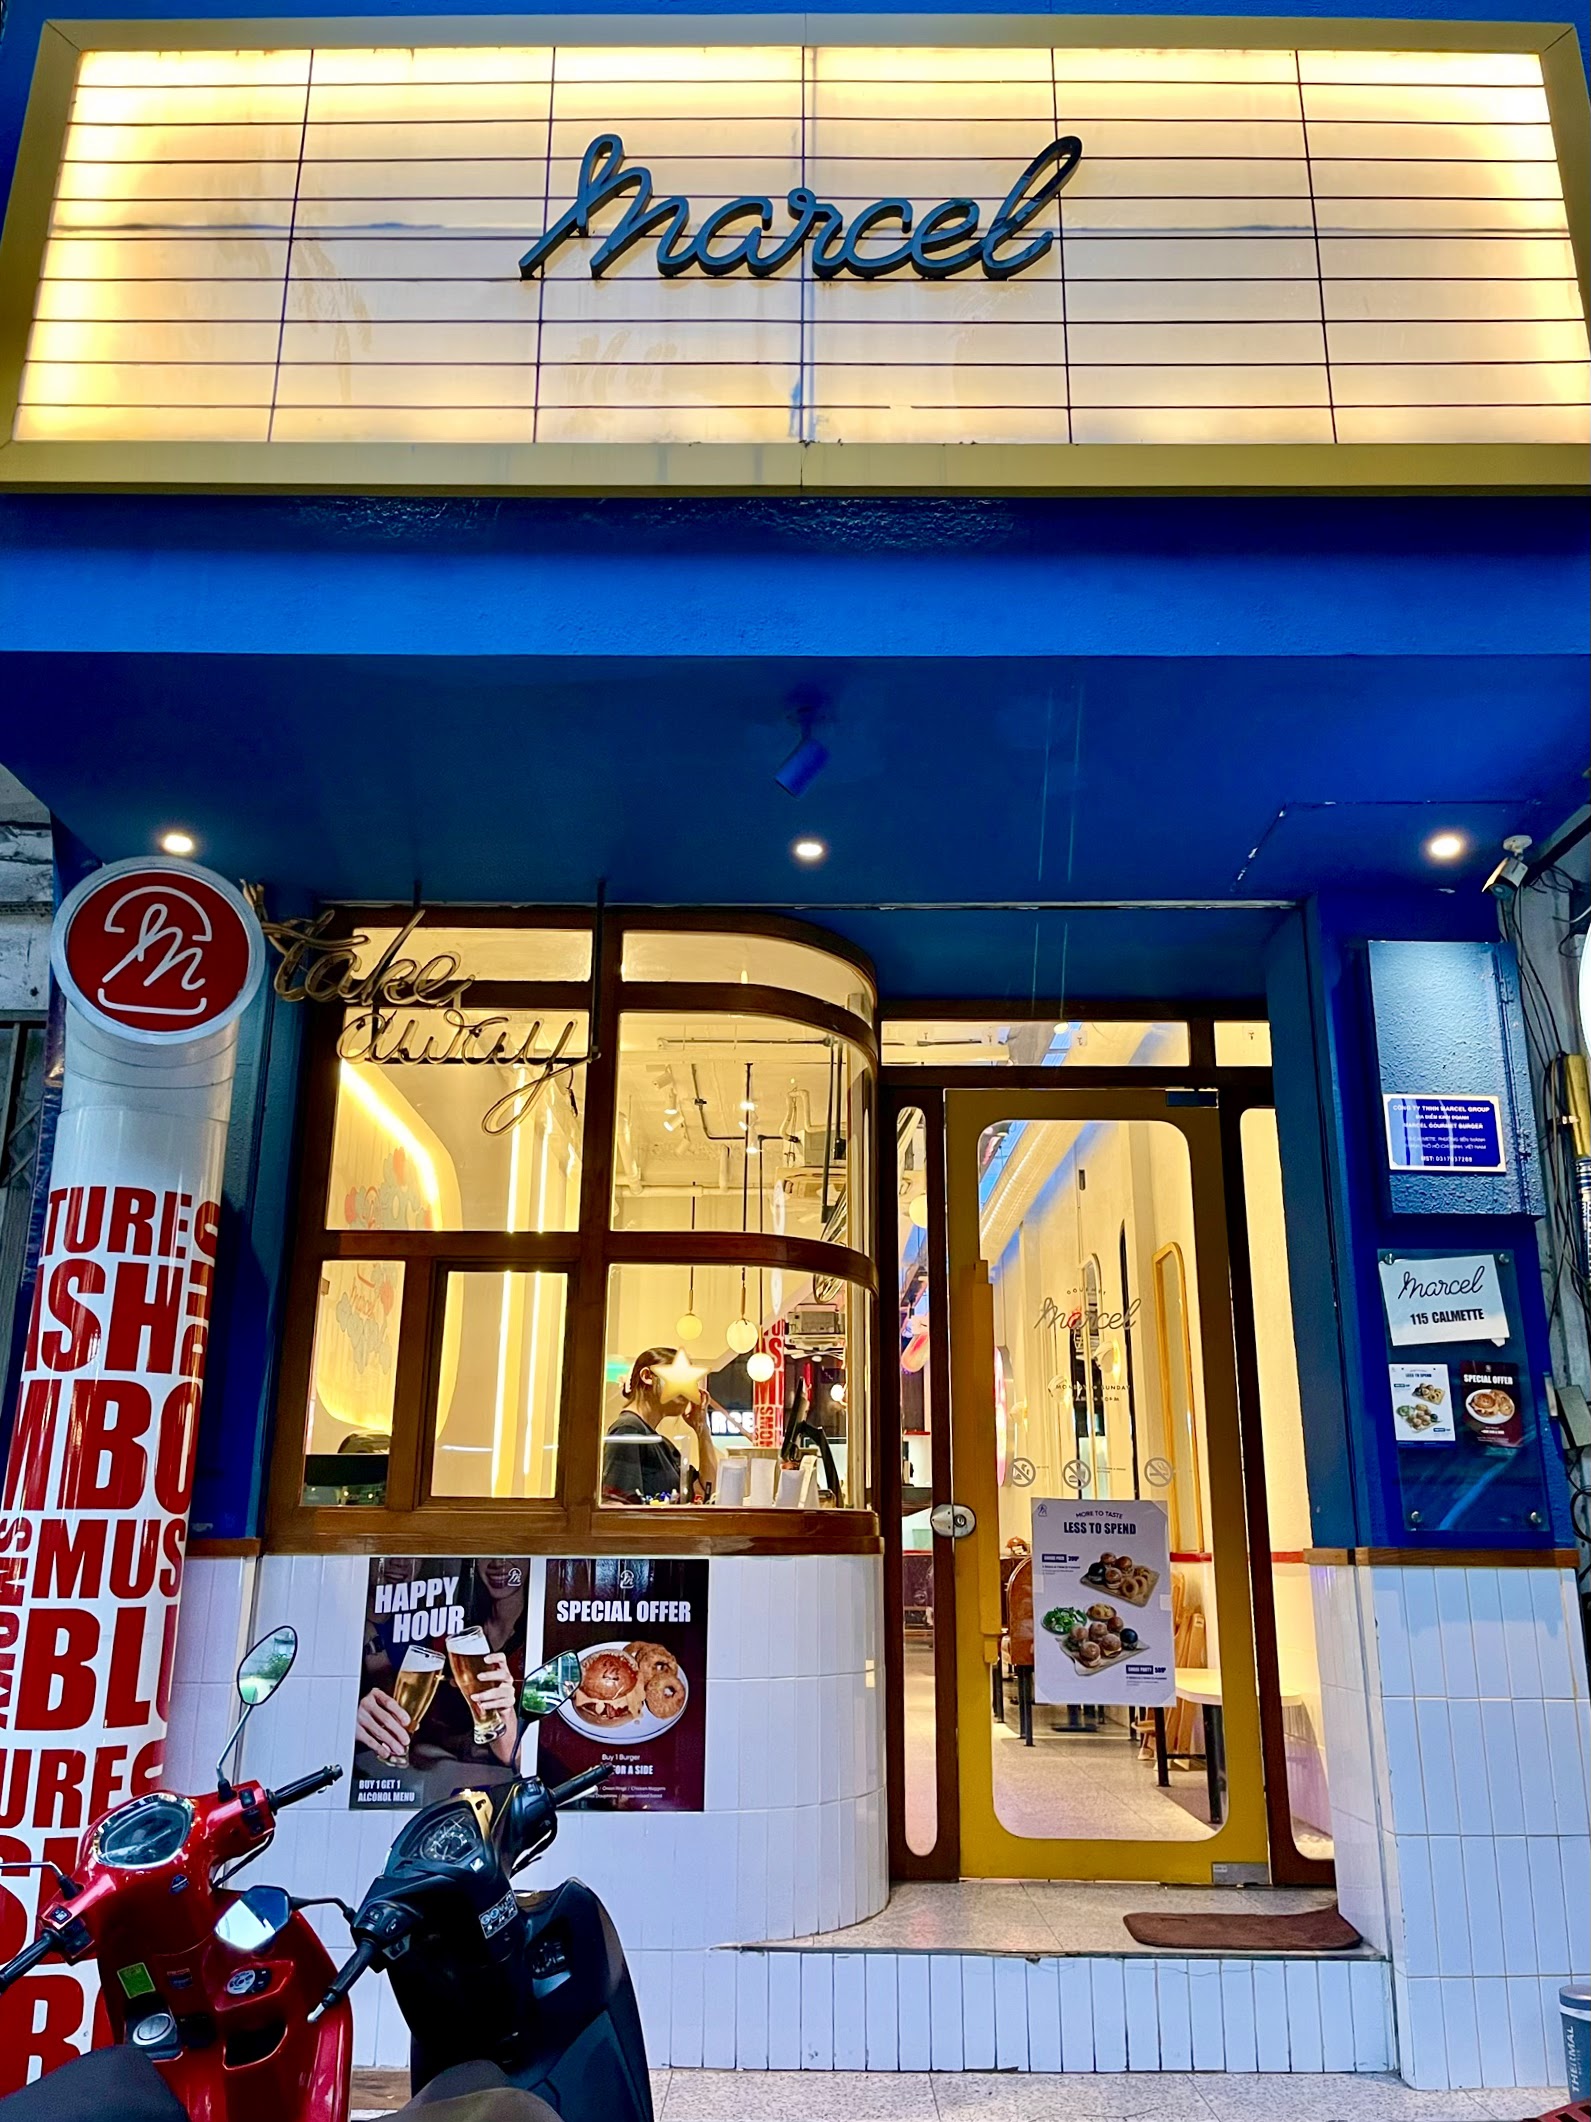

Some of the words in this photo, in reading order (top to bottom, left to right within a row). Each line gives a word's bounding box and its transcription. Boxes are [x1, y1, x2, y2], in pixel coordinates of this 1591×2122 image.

[1410, 1312, 1429, 1325] 115
[1431, 1308, 1485, 1324] CALMETTE
[1463, 1374, 1491, 1384] SPECIAL
[1492, 1376, 1514, 1385] OFFER
[1075, 1510, 1094, 1518] MORE
[1105, 1510, 1124, 1519] TASTE
[1063, 1521, 1087, 1534] LESS
[1089, 1522, 1102, 1535] TO
[1104, 1522, 1137, 1535] SPEND
[374, 1576, 460, 1614] HAPPY
[556, 1599, 632, 1623] SPECIAL
[636, 1600, 691, 1623] OFFER
[392, 1605, 465, 1644] HOUR
[601, 1753, 614, 1762] Buy
[618, 1753, 640, 1762] Burger
[613, 1765, 627, 1775] OR
[627, 1765, 634, 1775] A
[634, 1765, 653, 1775] SIDE
[358, 1780, 375, 1790] BUY
[381, 1780, 395, 1789] GET
[357, 1792, 392, 1802] ALCOHOL
[392, 1791, 416, 1802] MENU
[1566, 2025, 1580, 2093] THERMAL
